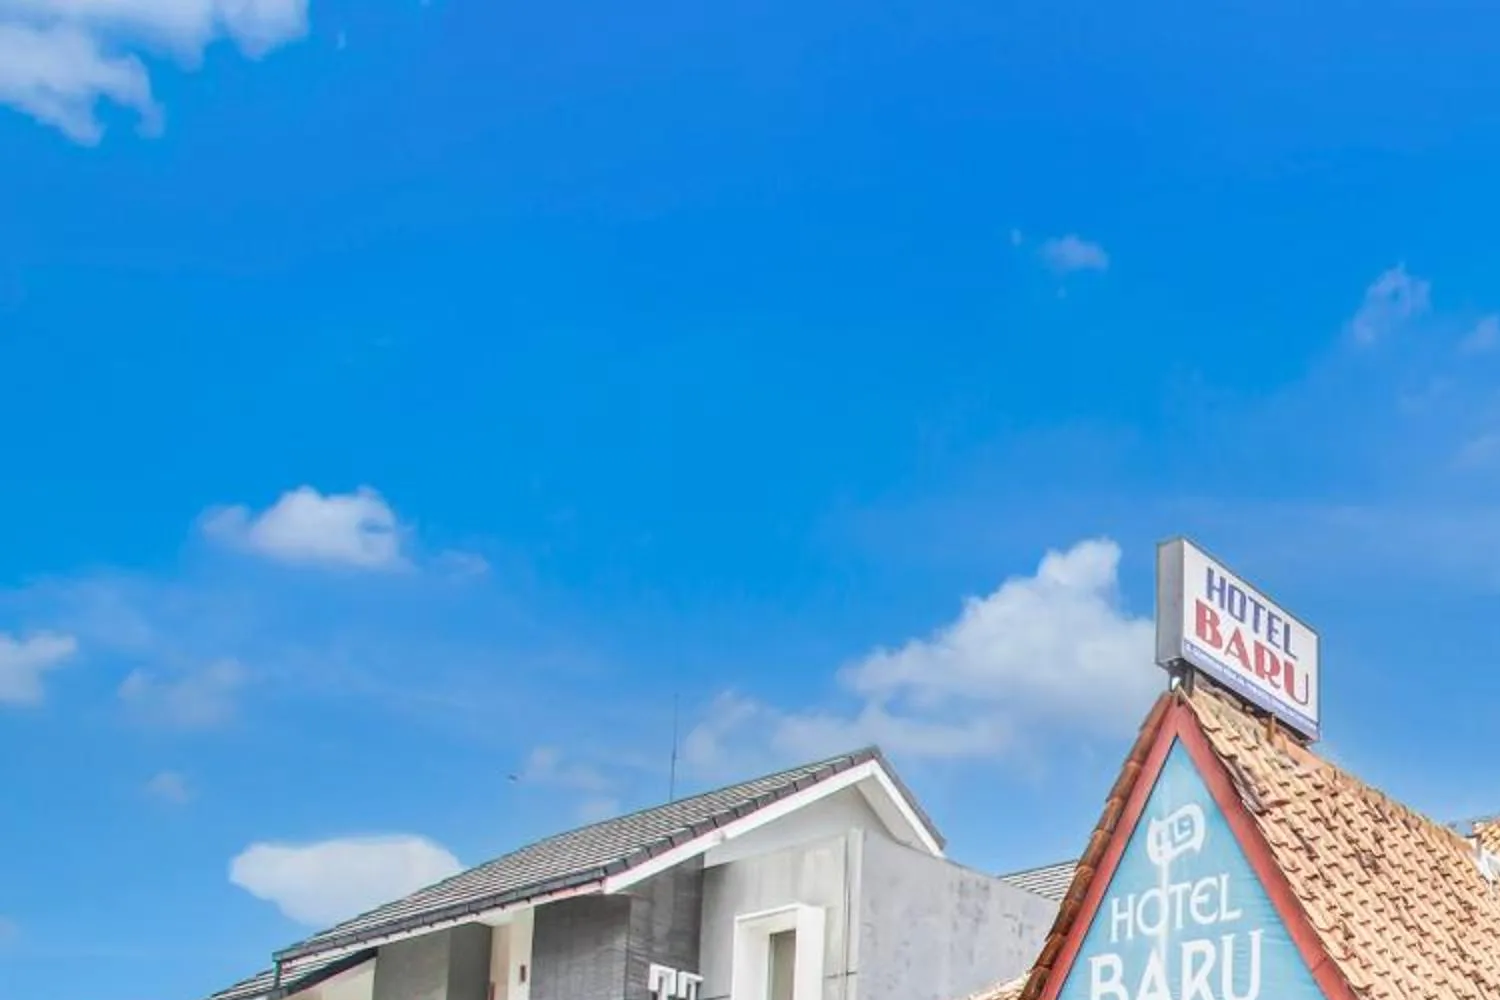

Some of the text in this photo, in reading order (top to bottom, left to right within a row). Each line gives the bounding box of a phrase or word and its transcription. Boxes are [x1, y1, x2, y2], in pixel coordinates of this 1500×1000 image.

[1196, 599, 1308, 704] BARU
[1207, 567, 1297, 659] HOTEL
[1112, 874, 1242, 942] HOTEL
